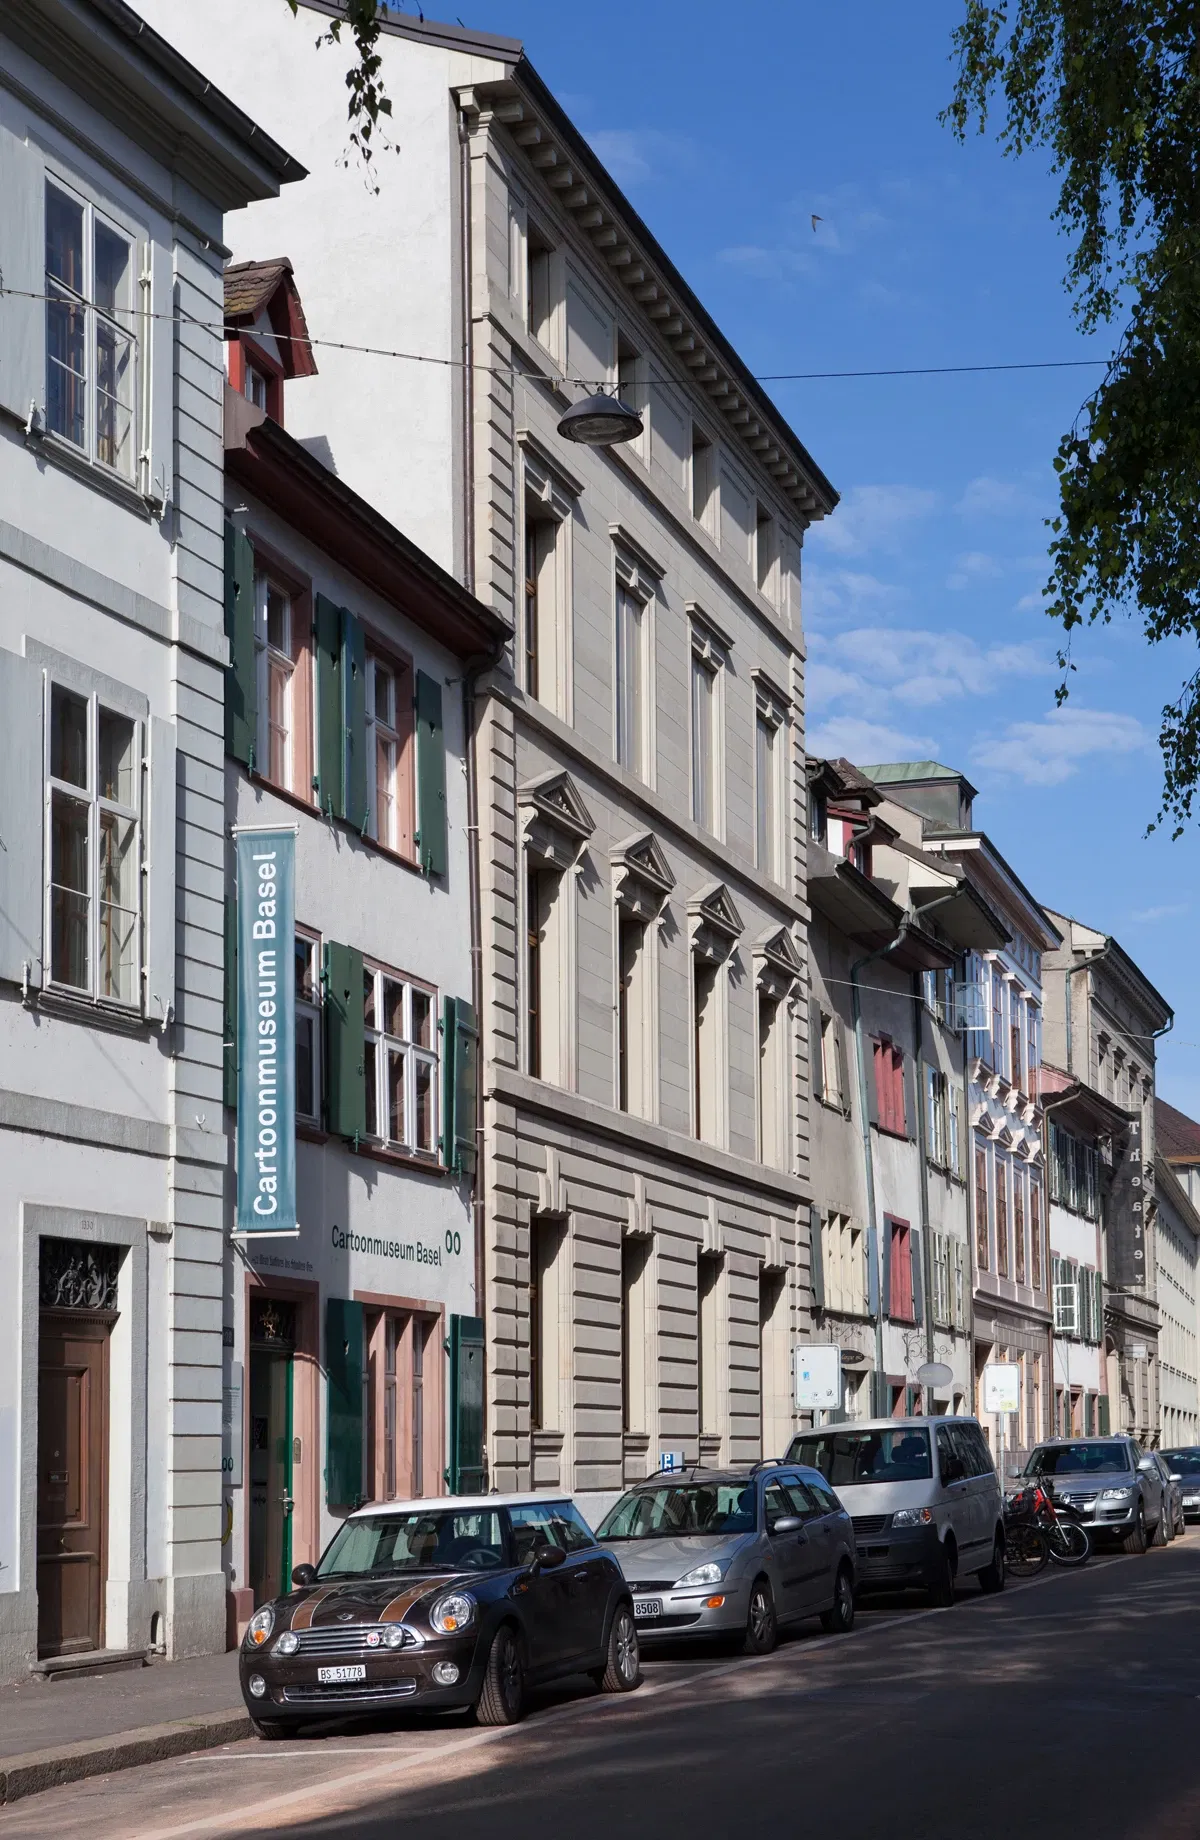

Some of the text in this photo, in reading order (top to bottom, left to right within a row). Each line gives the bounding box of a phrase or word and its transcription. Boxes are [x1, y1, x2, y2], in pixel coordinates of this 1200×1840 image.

[253, 851, 277, 1216] Cartoonmuseum Basel
[331, 1225, 415, 1261] Cartoonmuseum
[416, 1241, 442, 1266] Basel
[635, 1602, 659, 1614] 8508
